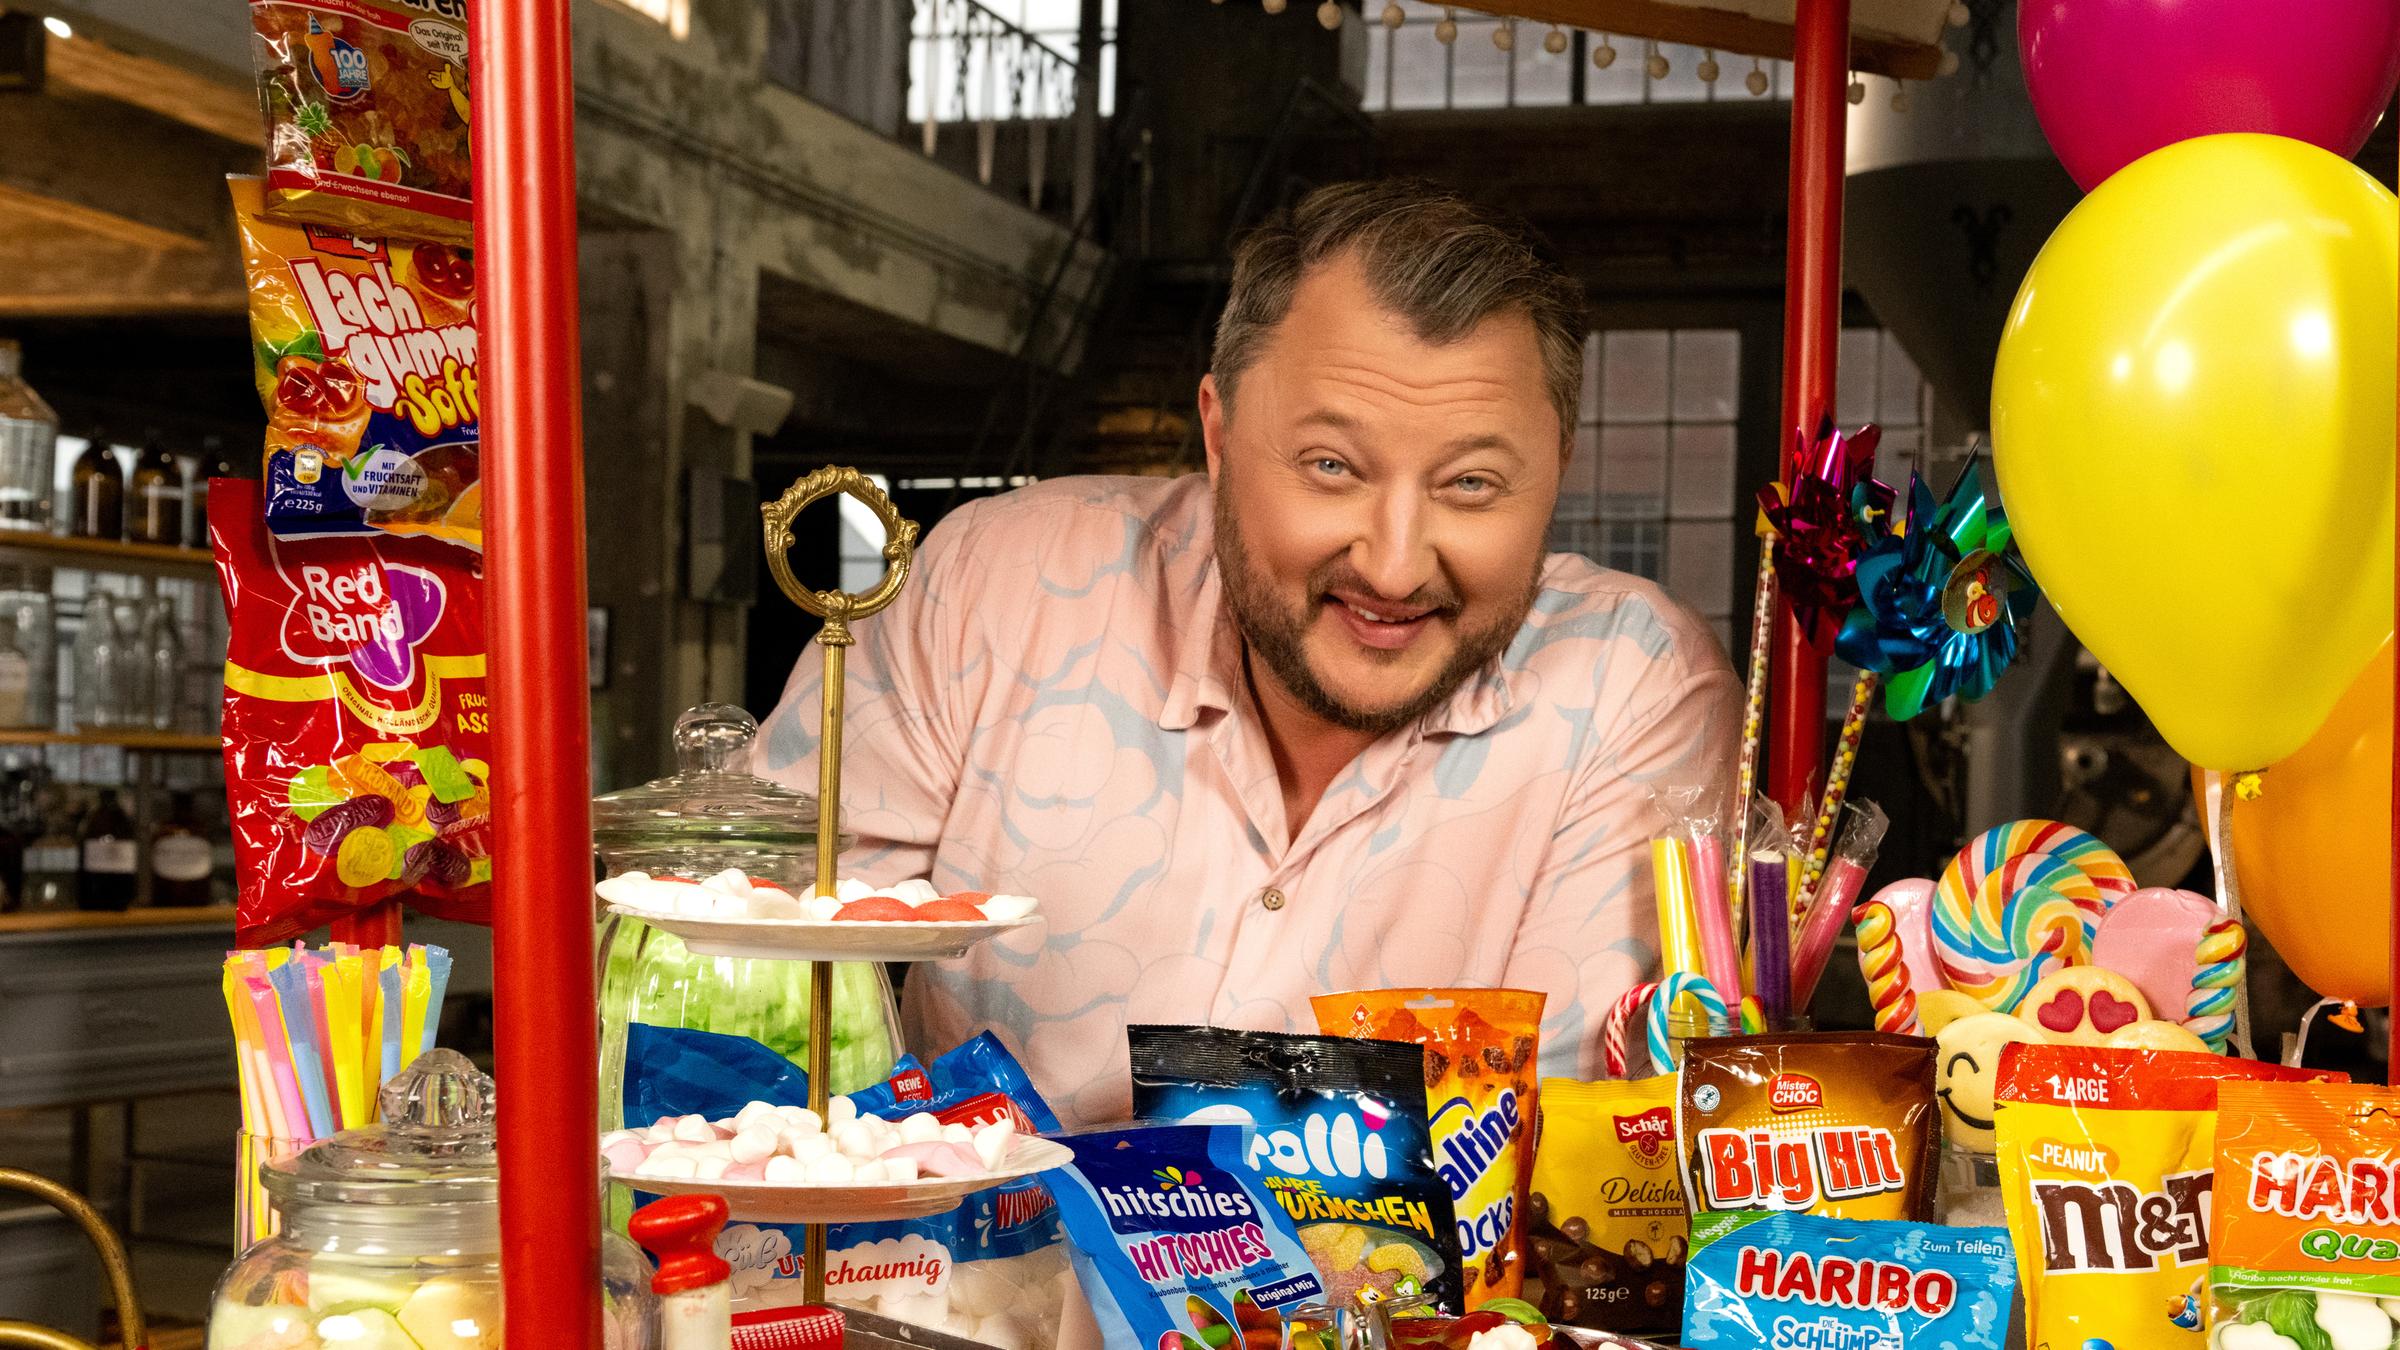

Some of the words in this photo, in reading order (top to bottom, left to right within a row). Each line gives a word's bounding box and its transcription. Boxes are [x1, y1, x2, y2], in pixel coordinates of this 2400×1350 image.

[414, 25, 431, 37] Das
[432, 28, 464, 42] Original
[427, 40, 440, 49] seit
[442, 40, 461, 52] 1922
[330, 49, 366, 69] 100
[339, 68, 368, 80] JAHRE
[334, 181, 378, 197] Erwachsene
[380, 190, 410, 203] ebenso!
[291, 260, 423, 352] Lach
[395, 357, 478, 435] Soft
[381, 461, 396, 471] MIT
[364, 470, 422, 486] FRUCHTSAFT
[352, 485, 368, 494] UND
[369, 485, 418, 498] VITAMINEN
[303, 562, 383, 611] Red
[306, 599, 405, 643] Band
[342, 686, 374, 720] ORIGINAL
[896, 1075, 923, 1093] REWE
[1776, 1080, 1812, 1091] Mister
[2052, 1076, 2110, 1103] LARGE
[1773, 1090, 1818, 1103] CHOC
[1619, 1115, 1669, 1137] Schär
[1438, 1091, 1519, 1201] altine
[1629, 1144, 1670, 1167] GLUTEN-FREE
[1708, 1133, 1815, 1202] Big
[1822, 1131, 1901, 1190] Hit
[2042, 1143, 2107, 1174] PEANUT
[1264, 1175, 1327, 1195] AURE
[1100, 1184, 1252, 1218] hitschies
[1613, 1207, 1638, 1217] MILK
[1128, 1221, 1274, 1283] HITSCHIES
[1922, 1240, 1951, 1253] Zum
[1955, 1239, 2003, 1257] Teilen
[2301, 1228, 2400, 1261] Qua
[825, 1252, 945, 1286] chaumig
[1148, 1286, 1187, 1299] Kaubonbon
[1207, 1279, 1228, 1291] Candy
[1230, 1270, 1260, 1284] Bonbons
[1256, 1284, 1296, 1304] Original
[1297, 1278, 1316, 1293] Mix
[1738, 1247, 1954, 1315] HARIBO
[2267, 1275, 2298, 1283] macht
[2299, 1275, 2330, 1284] Kinder
[2332, 1276, 2352, 1286] froh
[1822, 1319, 1835, 1329] DIE
